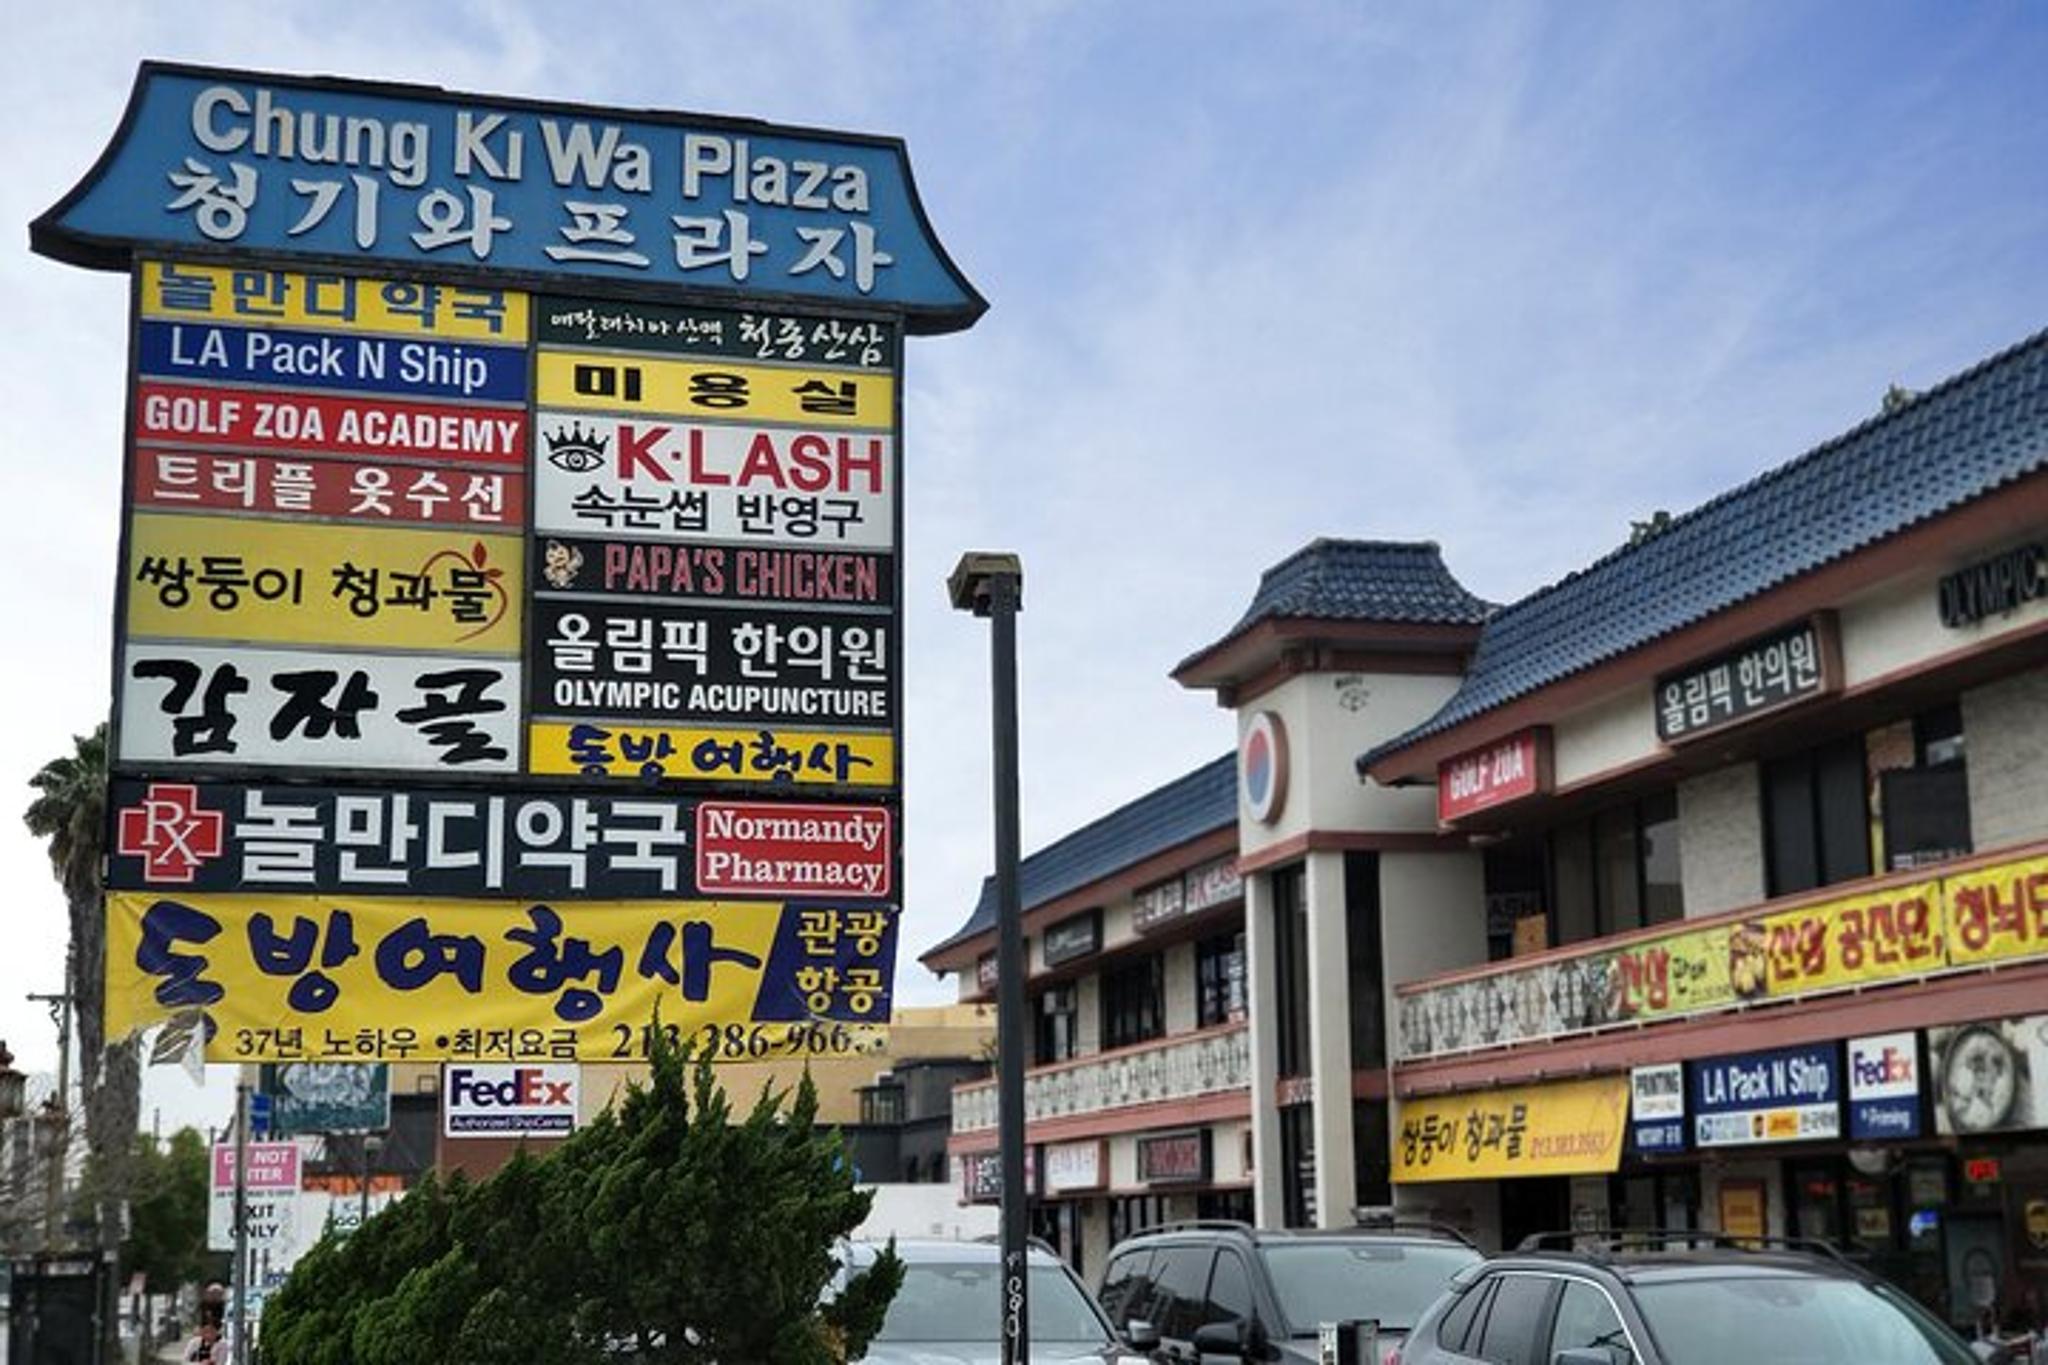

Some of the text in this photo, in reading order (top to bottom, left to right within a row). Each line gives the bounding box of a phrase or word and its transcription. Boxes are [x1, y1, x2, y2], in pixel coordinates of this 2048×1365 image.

[193, 87, 869, 212] Chung Ki Wa Plaza
[171, 325, 487, 394] LA Pack N Ship
[739, 314, 884, 366] 천종산삼
[574, 364, 857, 416] 미용실
[145, 395, 519, 454] GOLF ZOA ACADEMY
[153, 455, 504, 522] 트리플 옷수선
[571, 484, 864, 538] 속눈썹 반영구
[136, 556, 493, 622] 쌍둥이 청과물
[605, 544, 878, 601] PAPA'S CHICKEN
[546, 613, 887, 682] 올림픽 한의원
[554, 679, 886, 716] OLYMPIC ACUPUNCTURE
[1662, 630, 1817, 734] 올림픽 한의원
[132, 659, 508, 764] 감자골
[1450, 755, 1488, 800] GOLF
[236, 789, 686, 891] 놀만디약국
[707, 810, 883, 850] Normandy
[706, 853, 883, 892] Pharmacy
[798, 910, 888, 956] 관광
[796, 966, 884, 1013] 항공
[235, 1028, 302, 1059] 37년
[322, 1028, 419, 1059] 노하우
[1854, 1047, 1911, 1086] FedEx
[452, 1069, 572, 1106] FedEx
[1703, 1055, 1829, 1104] LA Pack N Ship
[253, 1151, 289, 1164] NOT
[1402, 1114, 1459, 1167] 쌍둥이
[1465, 1104, 1528, 1161] 청과물
[230, 1168, 282, 1181] TER
[238, 1205, 274, 1219] XIT
